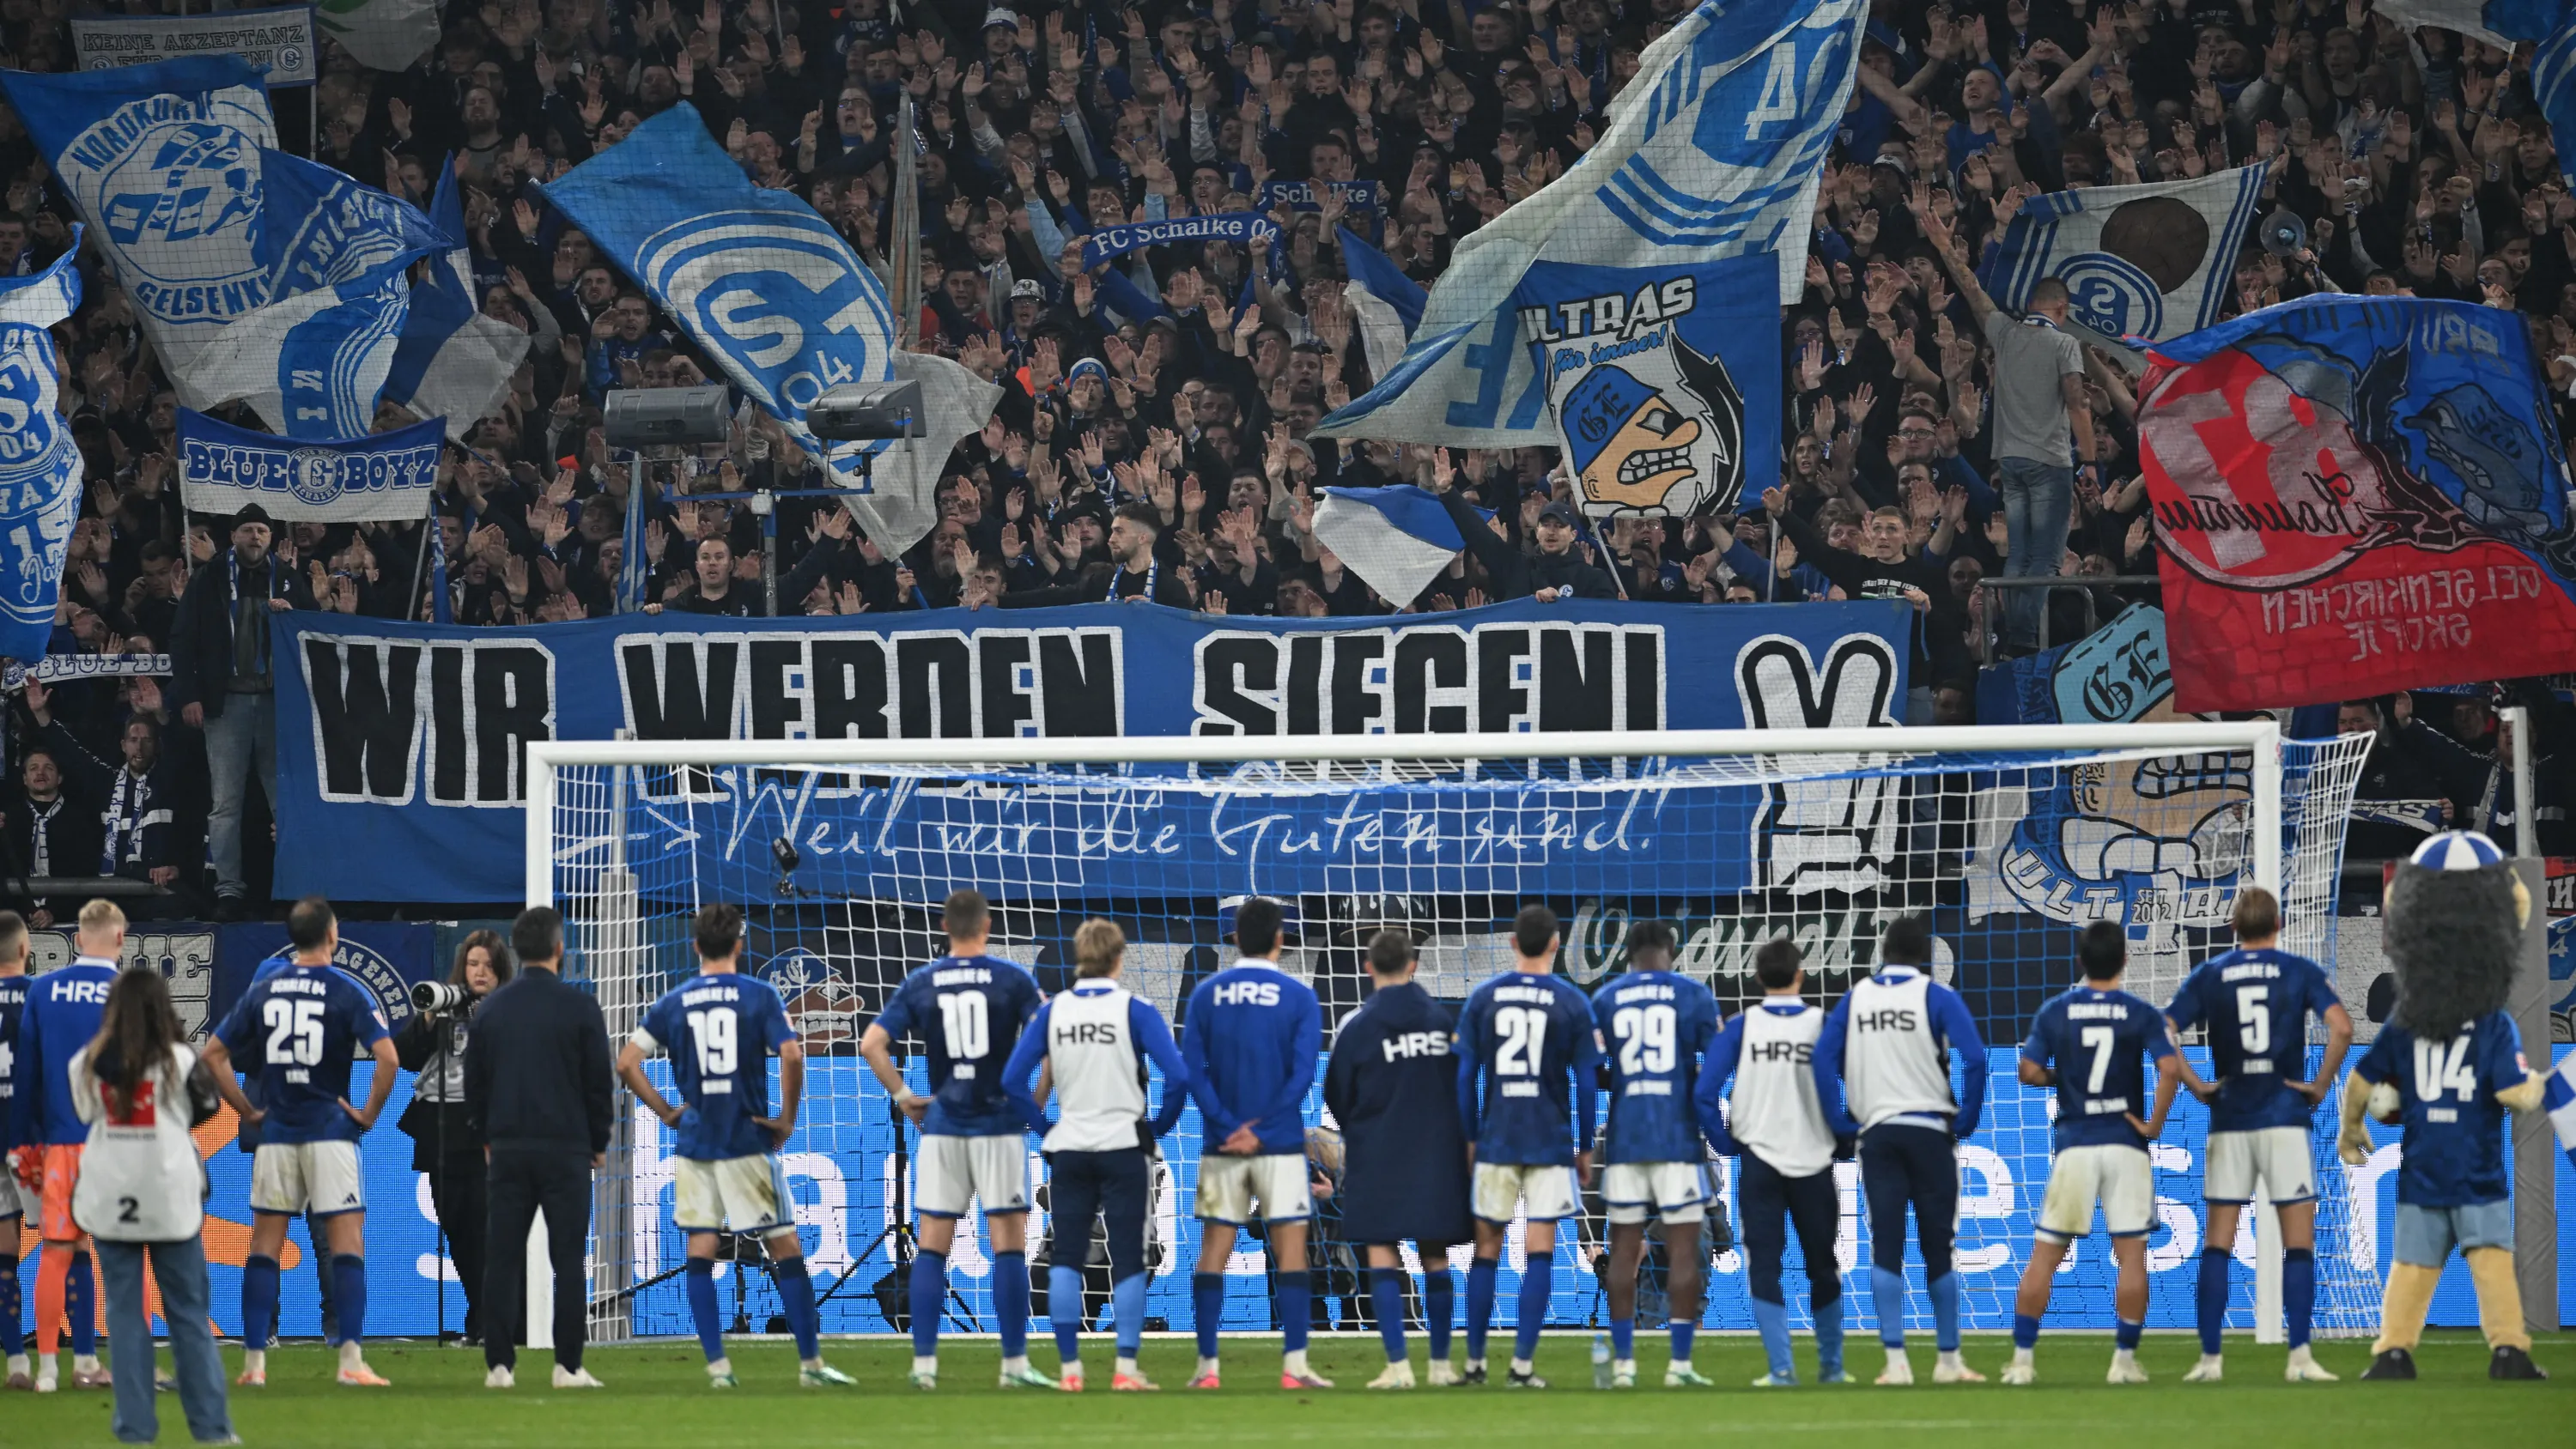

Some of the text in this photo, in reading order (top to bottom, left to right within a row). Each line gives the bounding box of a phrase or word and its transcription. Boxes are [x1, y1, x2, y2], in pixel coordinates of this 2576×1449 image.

[83, 25, 305, 52] KEINE AKZEPTANZ
[71, 91, 216, 173] NORDKURV
[1273, 181, 1368, 204] Schlke
[1093, 215, 1279, 256] FC Schalke 04
[709, 288, 804, 369] S
[1553, 324, 1668, 381] für immer!
[781, 350, 853, 410] 04
[184, 438, 291, 492] BLUE
[343, 444, 439, 493] BOYZ
[36, 653, 123, 677] BLUE
[298, 630, 556, 807] WIR
[615, 626, 1125, 804] WERDEN
[721, 755, 1678, 896] Weil wir die Guten sind!
[2131, 902, 2172, 925] 2002
[51, 979, 112, 1003] HRS
[312, 979, 327, 997] 04
[333, 946, 409, 1021] AGENER
[1212, 980, 1280, 1007] HRS
[263, 997, 326, 1067] 25
[687, 1006, 738, 1076] 19
[937, 989, 990, 1059] 10
[1057, 1023, 1117, 1045] HRS
[1494, 1005, 1548, 1076] 21
[1613, 1003, 1677, 1076] 29
[1856, 1009, 1917, 1034] HRS
[2236, 985, 2270, 1054] 5
[1382, 1030, 1450, 1064] HRS
[1751, 1040, 1814, 1064] HRS
[2081, 1026, 2115, 1094] 7
[117, 1195, 141, 1224] 2
